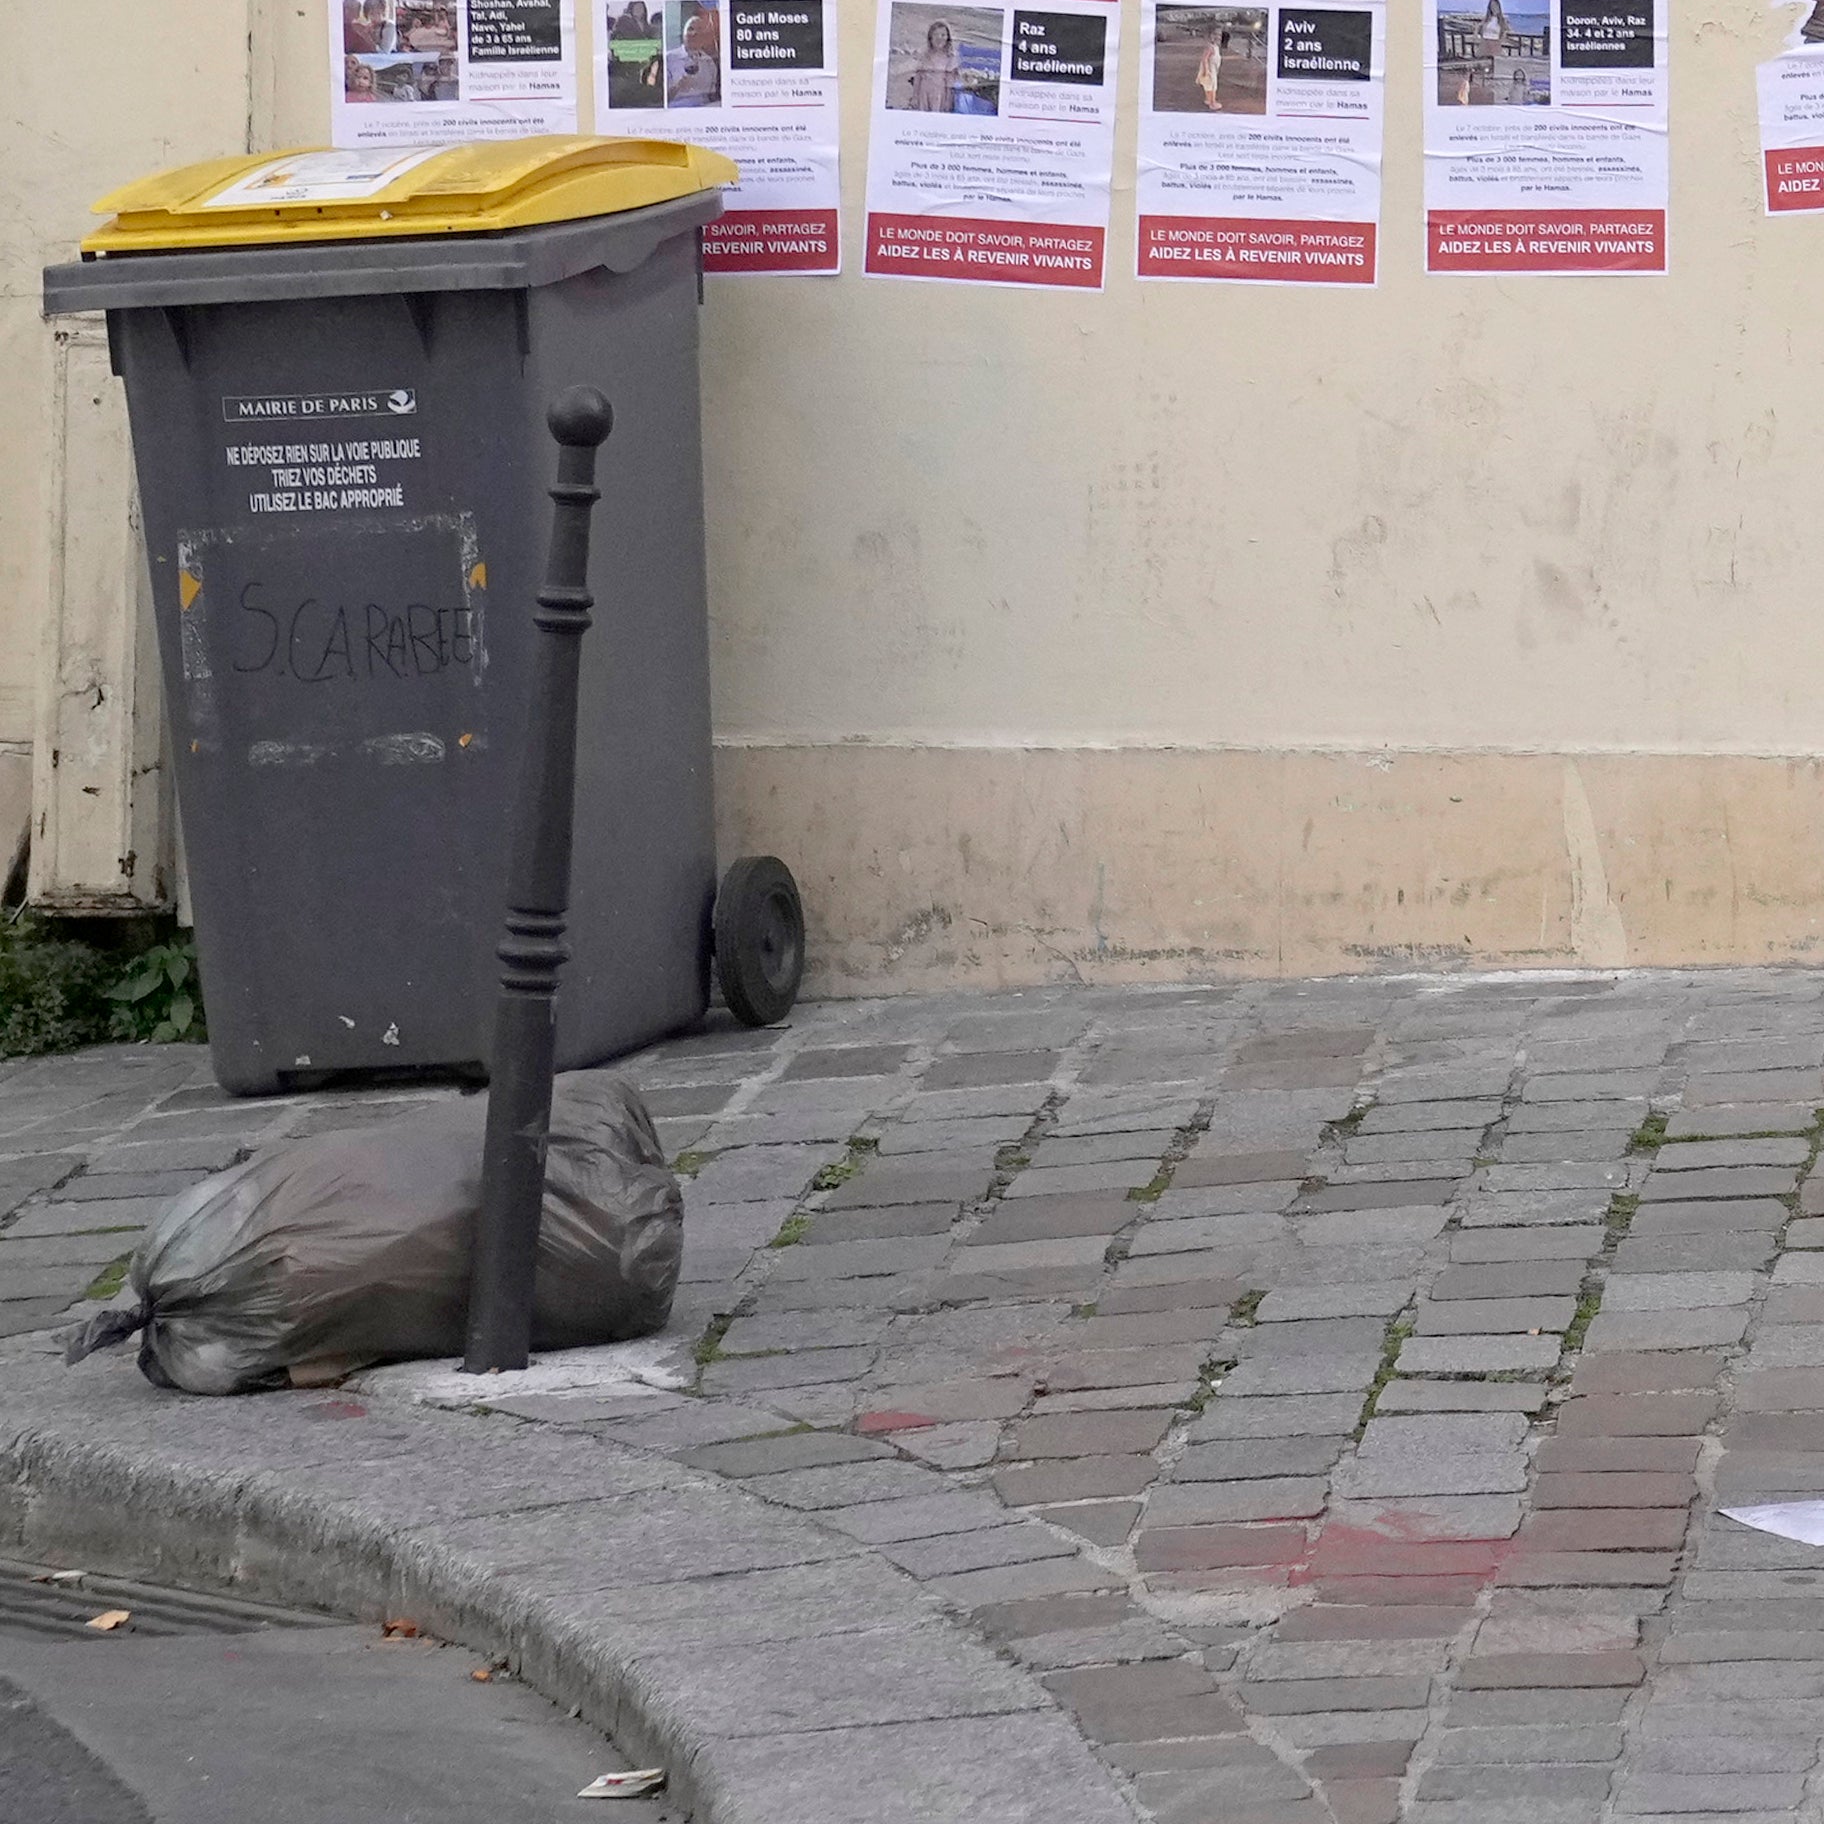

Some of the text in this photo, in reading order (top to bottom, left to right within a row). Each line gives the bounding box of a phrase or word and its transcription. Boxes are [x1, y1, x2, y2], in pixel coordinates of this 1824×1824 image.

[1020, 22, 1044, 35] Raz
[1019, 40, 1056, 54] 4 ans
[240, 397, 377, 415] MAIRIE DE PARIS
[226, 439, 420, 465] NE DÉPOSEZ RIEN SUR LA VOIE PUBLIQUE
[272, 462, 376, 487] TRIEZ VOS DÉCHETS
[250, 483, 404, 512] UTILISEZ LE BAC APPROPRIÉ
